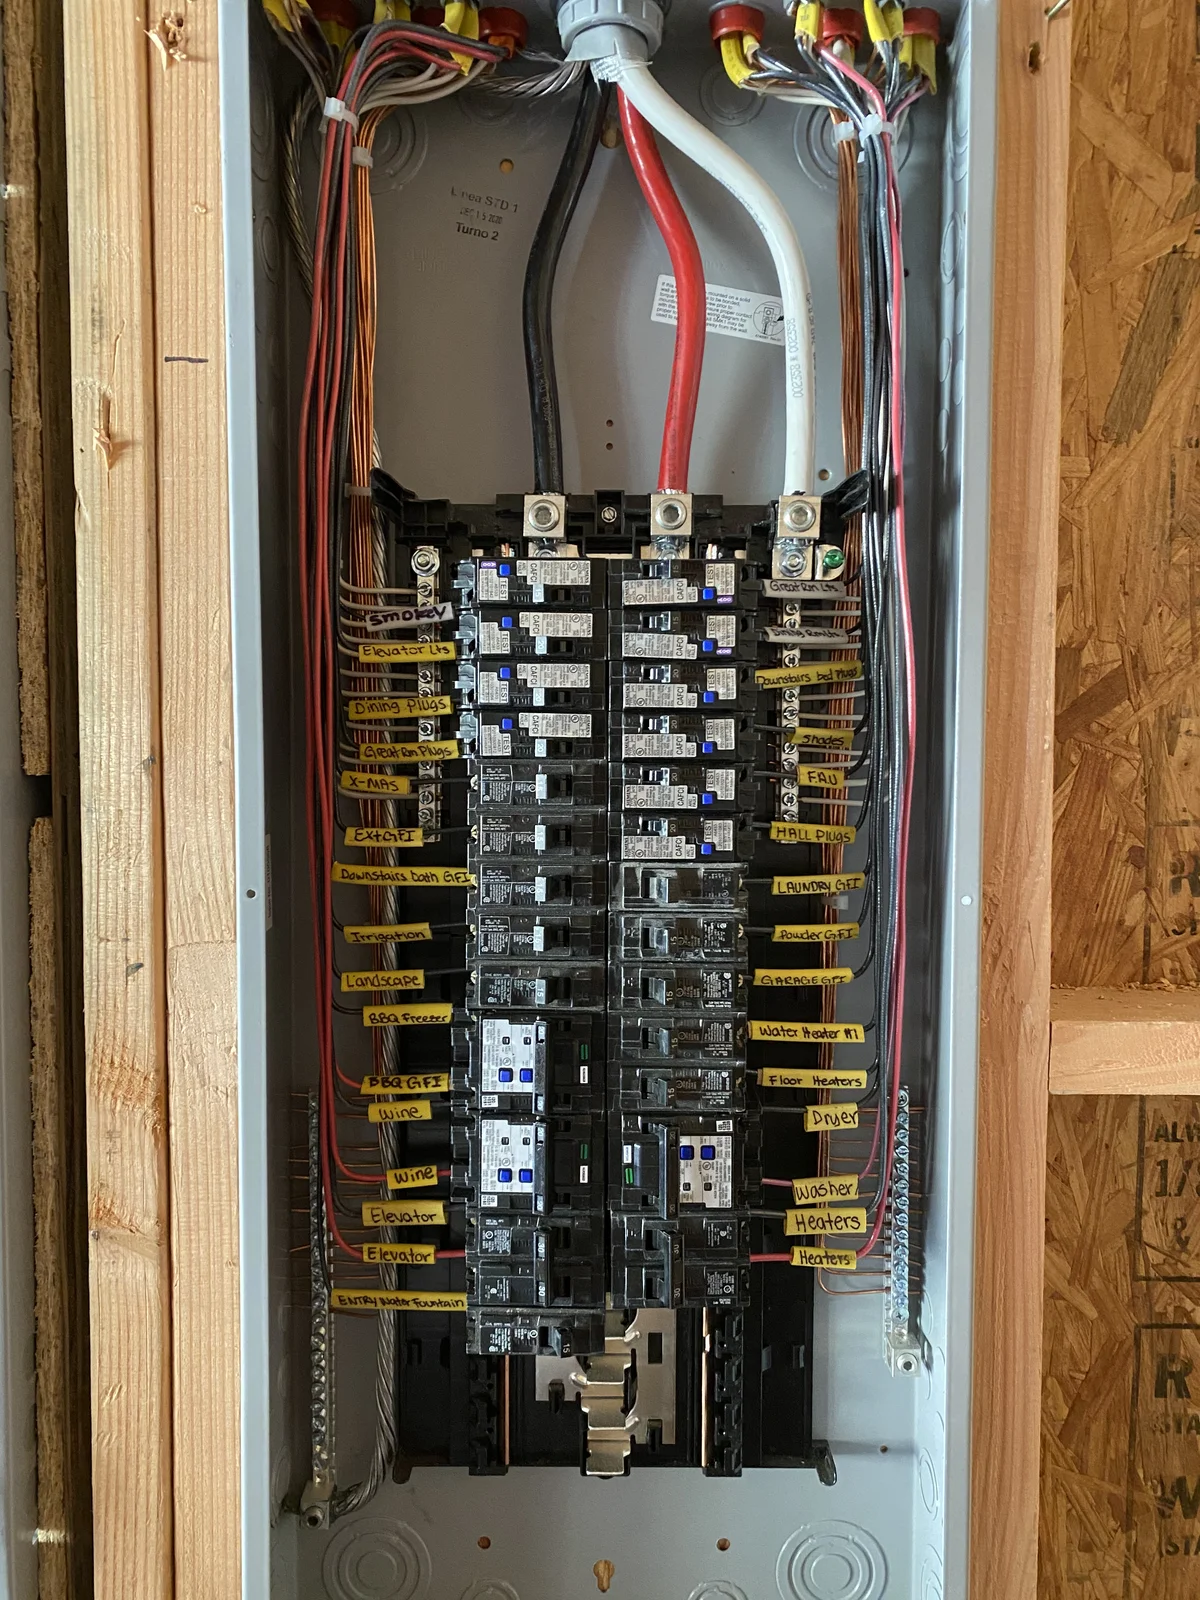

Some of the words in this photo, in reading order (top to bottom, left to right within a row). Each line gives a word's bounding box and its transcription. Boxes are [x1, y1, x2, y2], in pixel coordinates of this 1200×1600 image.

[485, 196, 509, 210] STD
[513, 204, 518, 212] 1
[456, 222, 489, 238] Turno
[491, 231, 499, 241] 2
[673, 566, 679, 574] 15
[770, 580, 800, 592] Great
[801, 583, 819, 592] Rm
[673, 617, 679, 625] 15
[362, 646, 425, 657] Elevator
[673, 668, 679, 678] 20
[756, 673, 811, 686] Downstairs
[355, 701, 400, 714] Dining
[671, 720, 678, 729] 20
[421, 746, 452, 759] Plugs
[349, 775, 398, 791] X-MAS
[671, 772, 678, 782] 20
[670, 823, 676, 832] 20
[776, 827, 811, 840] HALL
[815, 829, 851, 843] Plugs
[341, 869, 407, 881] Downstairs
[411, 870, 439, 882] bath
[443, 873, 471, 882] GFI
[778, 880, 831, 894] LAUNDRY
[835, 878, 861, 890] GFI
[351, 931, 426, 943] Irrigation
[780, 928, 821, 940] Powder
[824, 928, 853, 940] GFI
[346, 974, 420, 988] Landscape
[761, 975, 818, 985] GARAGE
[821, 975, 847, 984] GFI
[368, 1013, 400, 1024] BBQ
[759, 1026, 798, 1037] Water
[803, 1029, 840, 1039] Heater
[368, 1076, 402, 1089] BBQ
[406, 1076, 442, 1089] GFI
[769, 1075, 803, 1085] Floor
[813, 1077, 862, 1086] Heaters
[812, 1110, 858, 1126] Dryer
[795, 1182, 853, 1200] Washer
[371, 1208, 437, 1223] Elevator
[796, 1214, 861, 1232] Heaters
[368, 1247, 431, 1263] Elevator
[800, 1250, 851, 1261] Heaters
[338, 1293, 377, 1306] ENTRY
[412, 1299, 464, 1308] Fountain
[562, 1342, 570, 1353] 15
[1154, 1353, 1193, 1398] R
